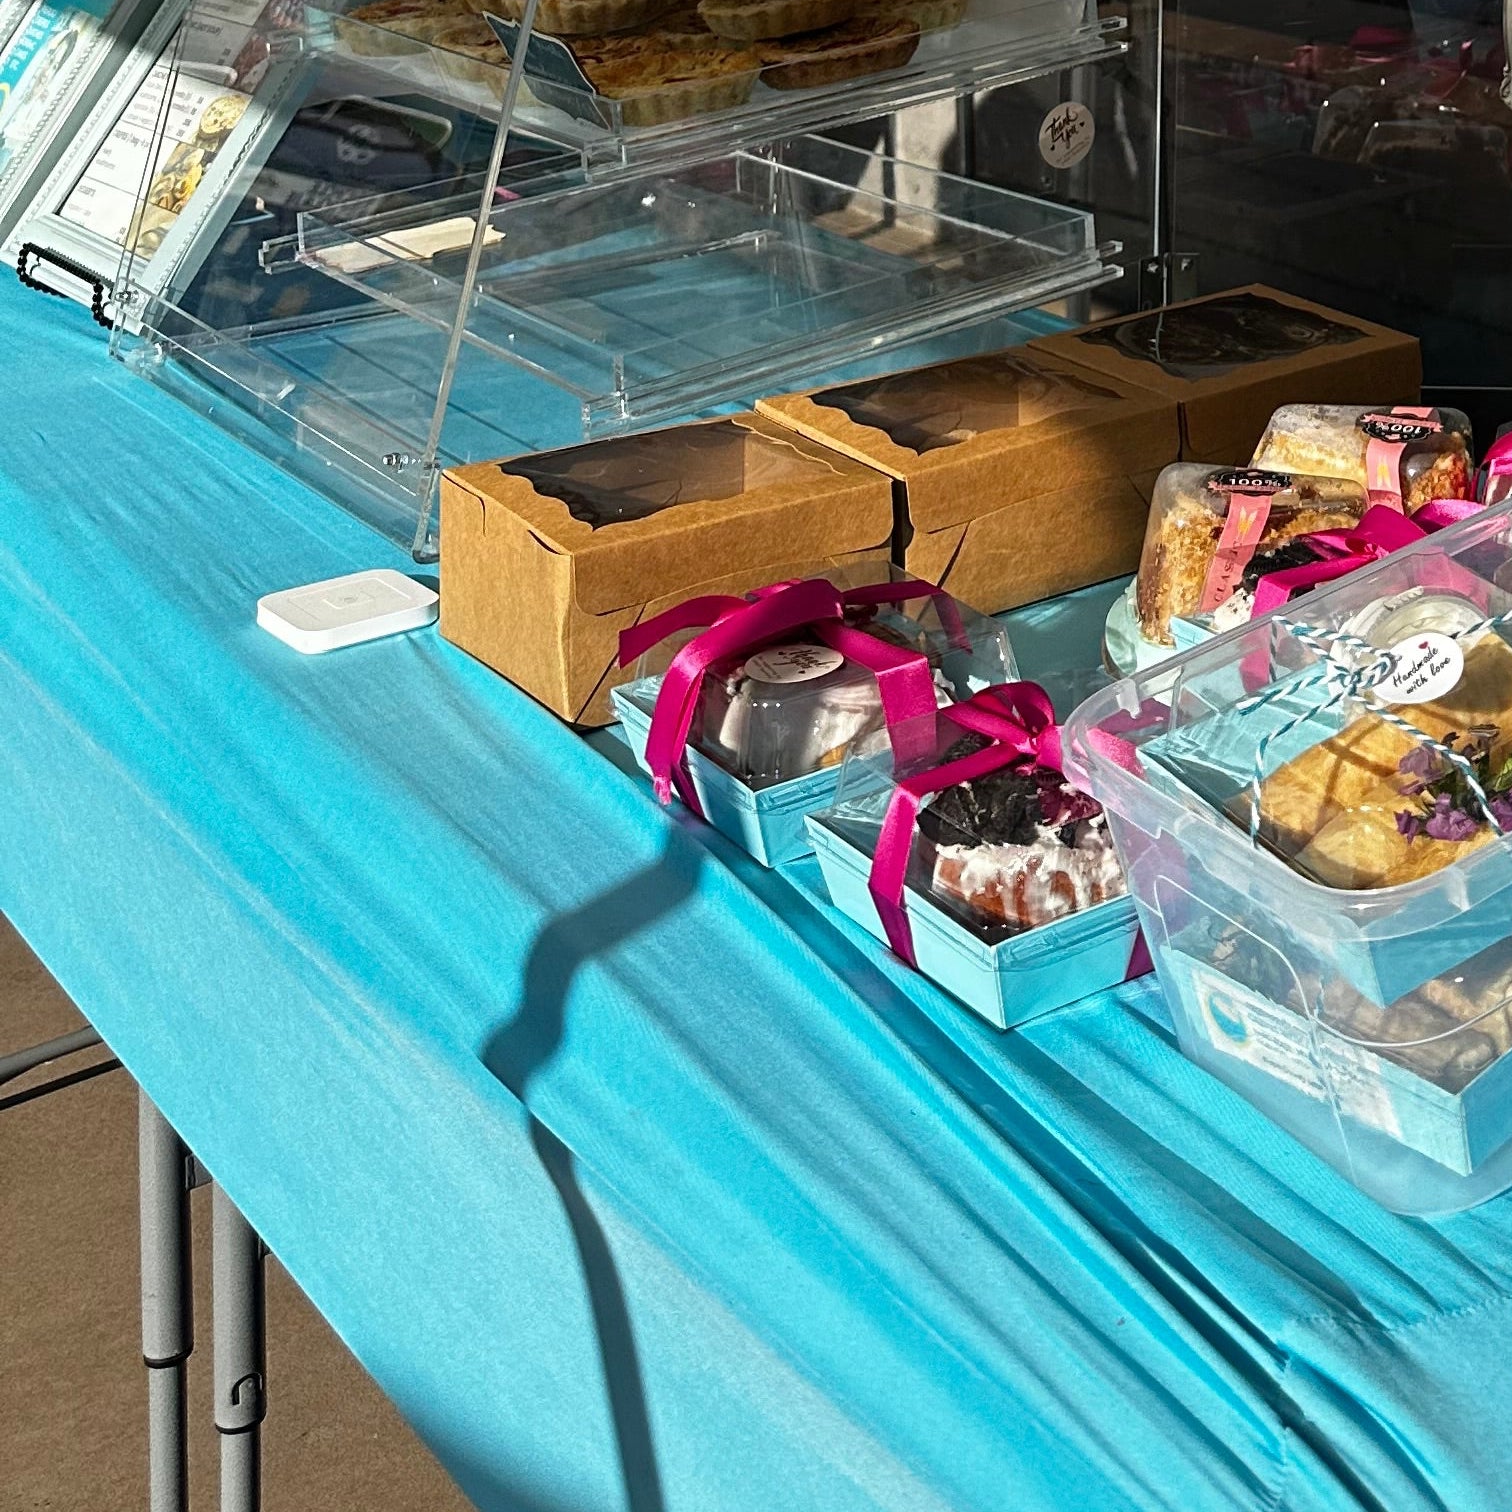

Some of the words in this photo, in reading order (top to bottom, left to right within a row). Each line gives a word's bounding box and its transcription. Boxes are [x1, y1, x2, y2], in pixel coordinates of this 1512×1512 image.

[1229, 478, 1281, 487] 100%
[1392, 646, 1438, 688] Handmade
[1430, 657, 1451, 677] love
